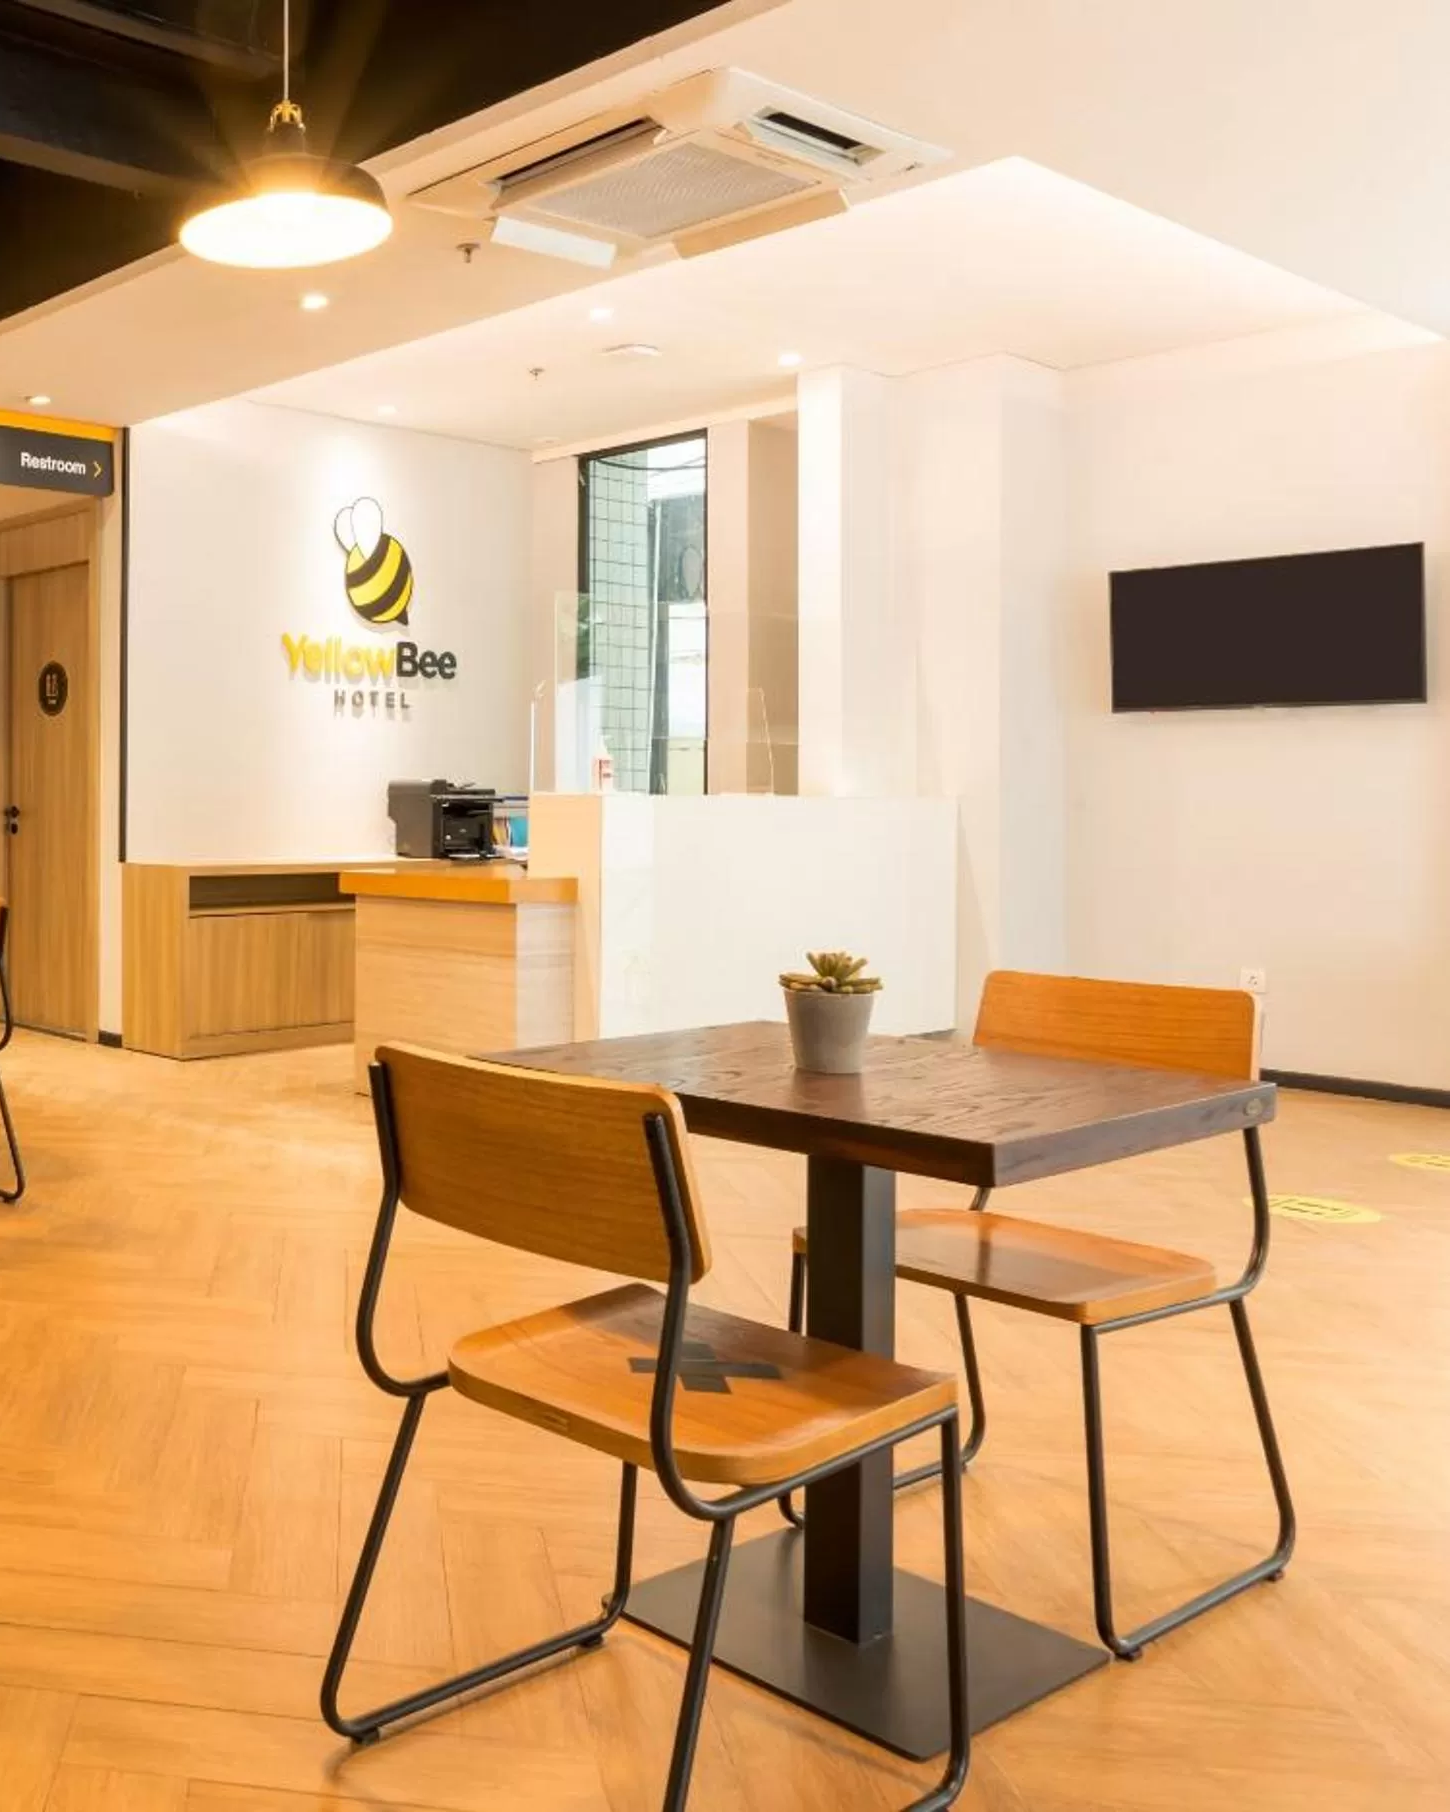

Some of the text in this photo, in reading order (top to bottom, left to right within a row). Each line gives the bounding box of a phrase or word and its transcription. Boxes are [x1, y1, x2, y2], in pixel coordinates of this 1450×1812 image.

[21, 452, 87, 475] Restroom
[281, 632, 457, 680] YellowBee
[334, 690, 411, 709] HOTEL
